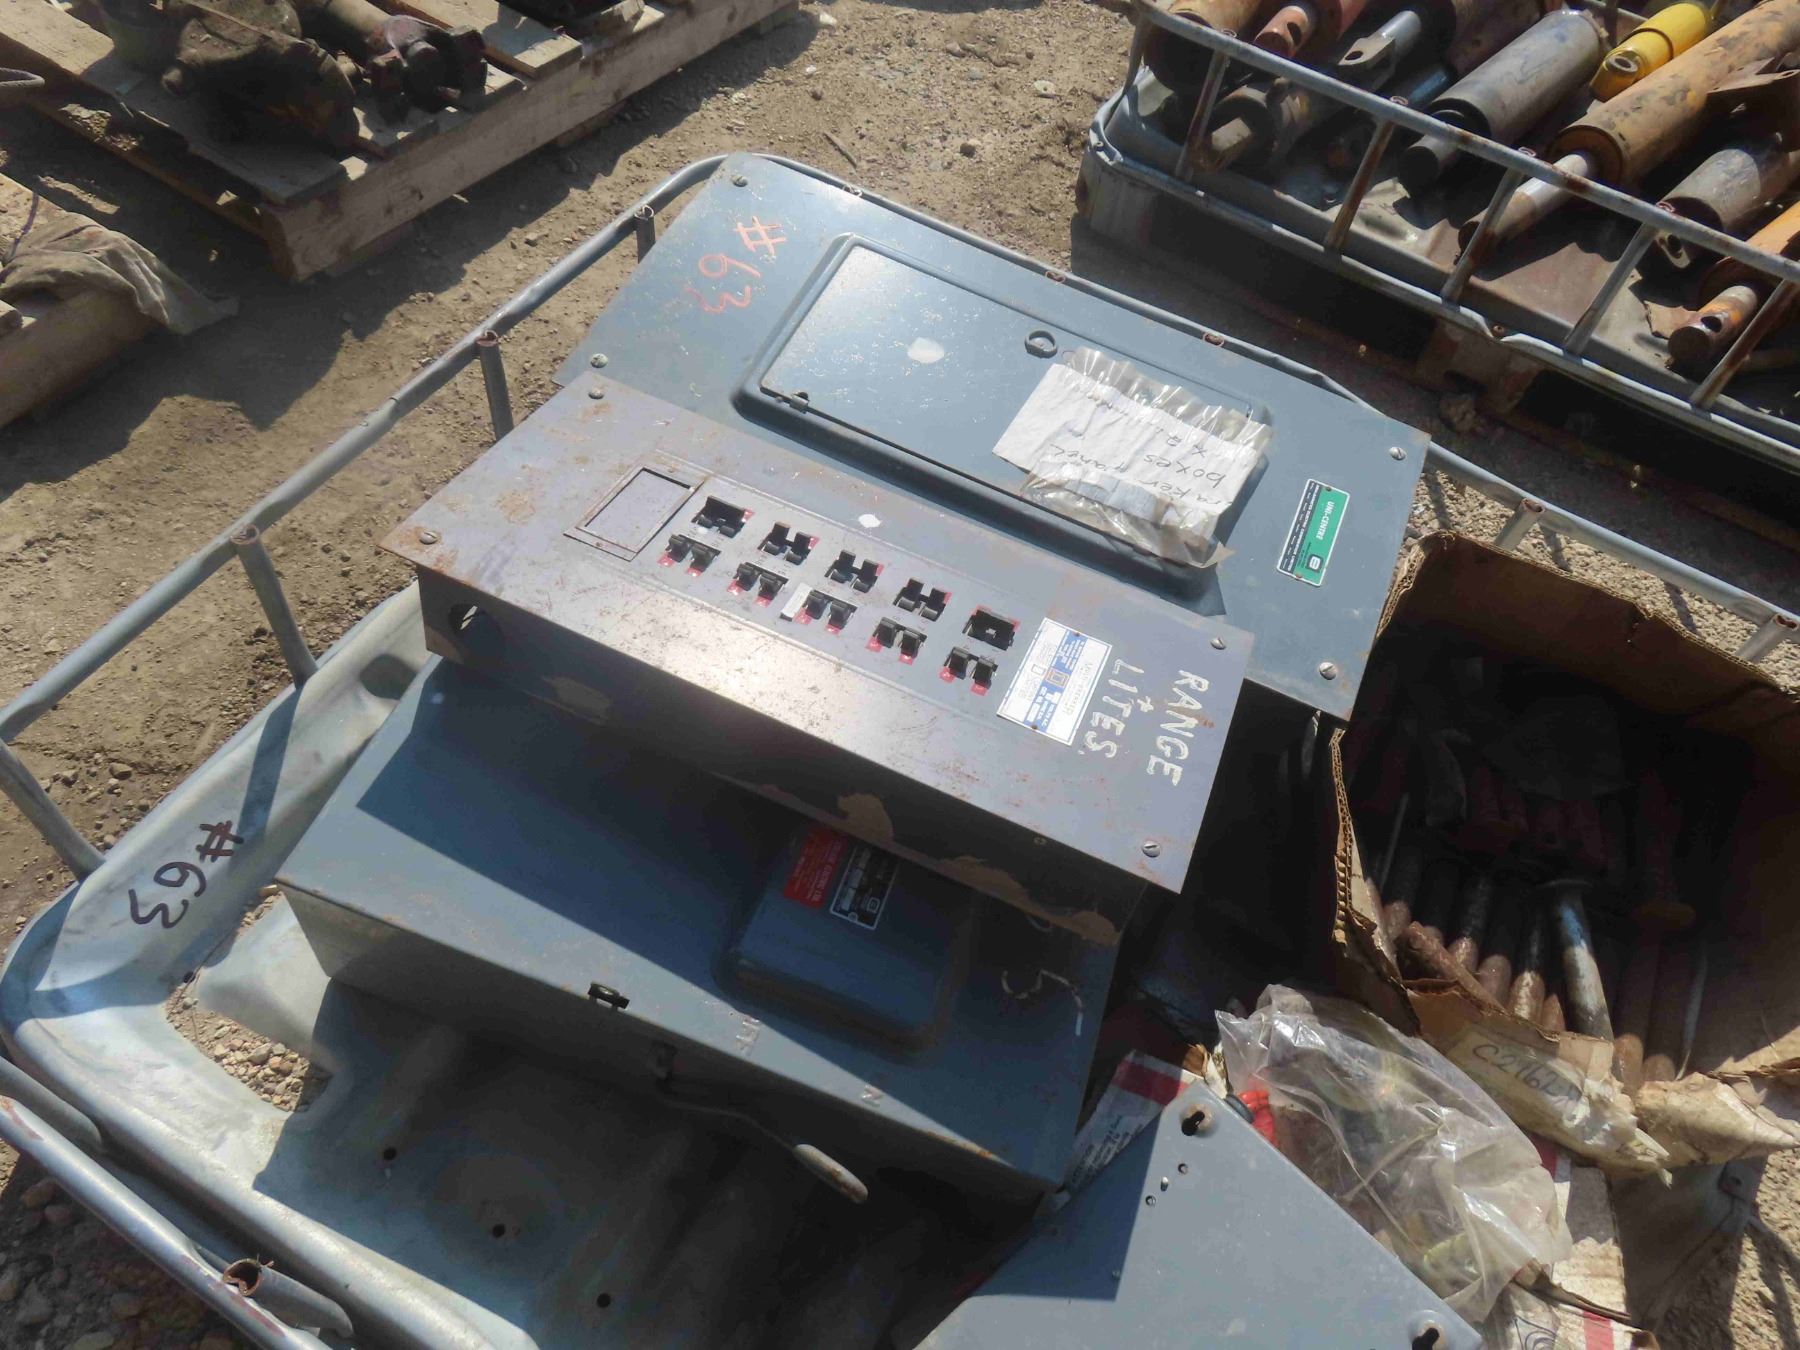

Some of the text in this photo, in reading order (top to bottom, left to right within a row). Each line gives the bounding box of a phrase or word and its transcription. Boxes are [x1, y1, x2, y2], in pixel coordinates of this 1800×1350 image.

[1143, 453, 1227, 489] boxes
[1315, 501, 1335, 540] UNI-CENTRE
[1146, 669, 1210, 787] RANGE
[128, 820, 245, 929] #63
